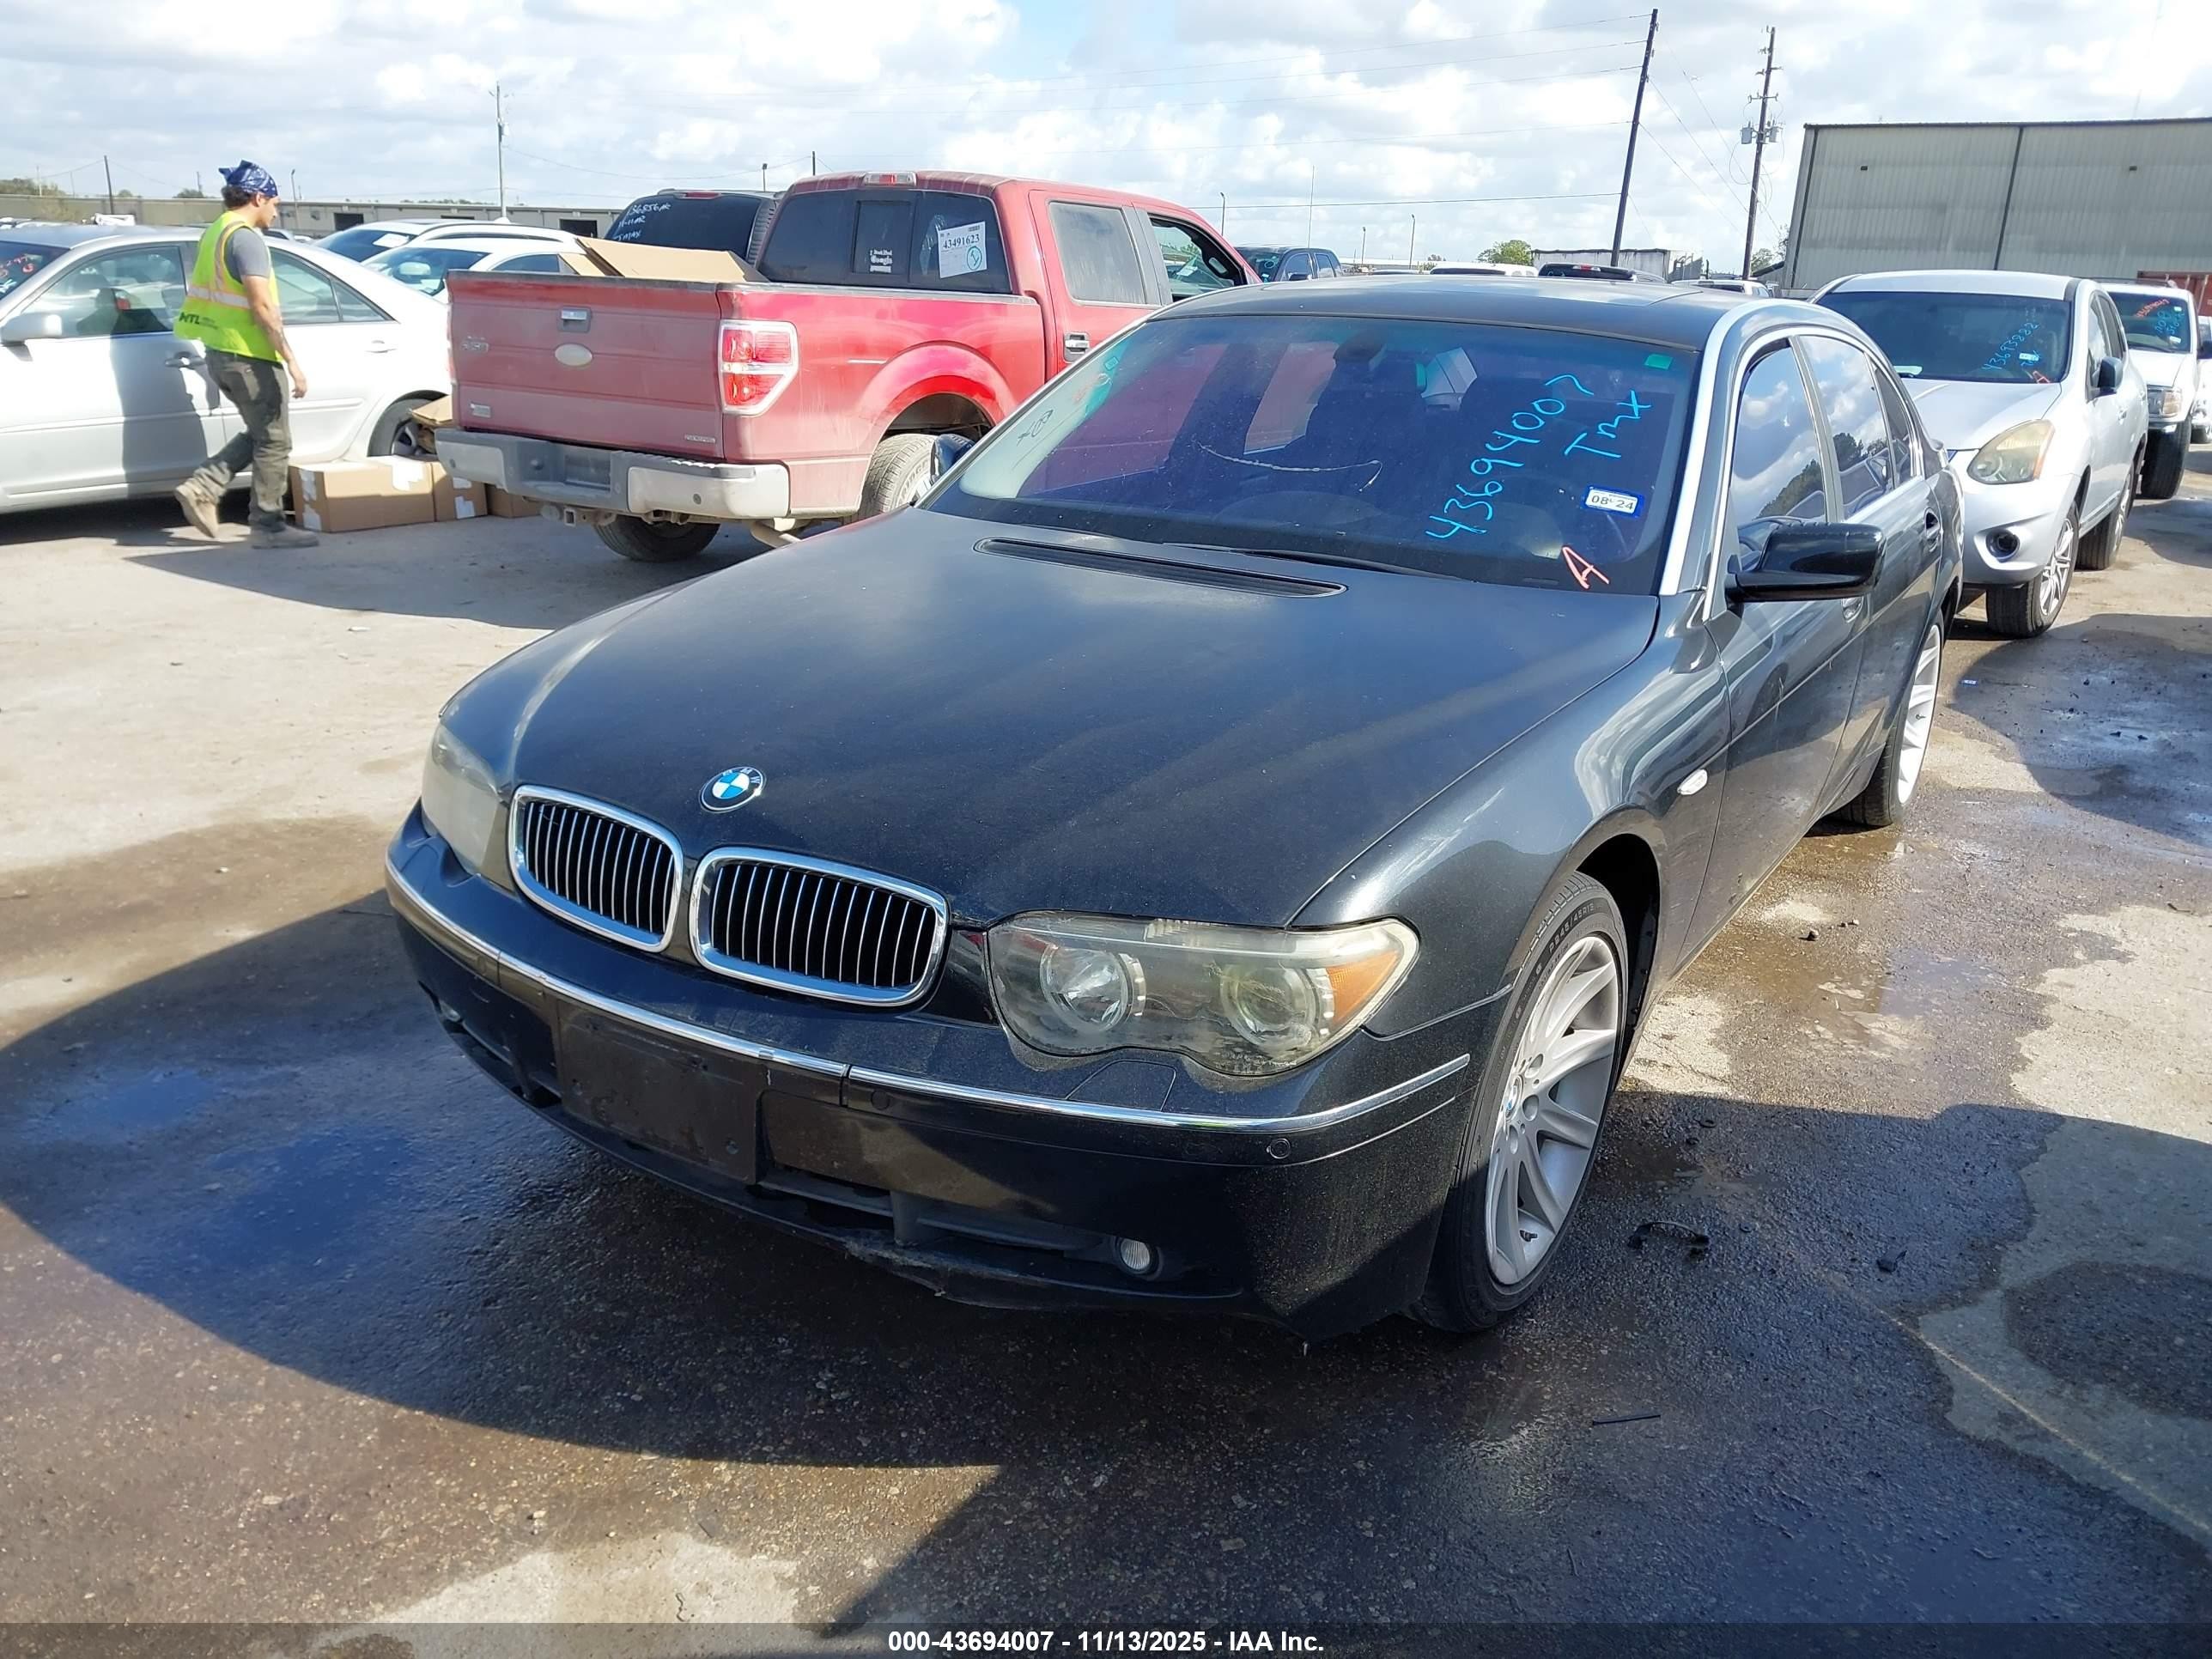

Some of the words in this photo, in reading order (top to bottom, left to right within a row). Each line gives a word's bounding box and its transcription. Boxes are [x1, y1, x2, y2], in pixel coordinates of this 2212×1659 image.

[944, 234, 980, 249] 43491623
[1425, 374, 1595, 539] 43694007
[1591, 495, 1608, 505] 08
[1615, 499, 1634, 510] 24
[1562, 546, 1610, 589] A
[722, 767, 762, 784] BMW
